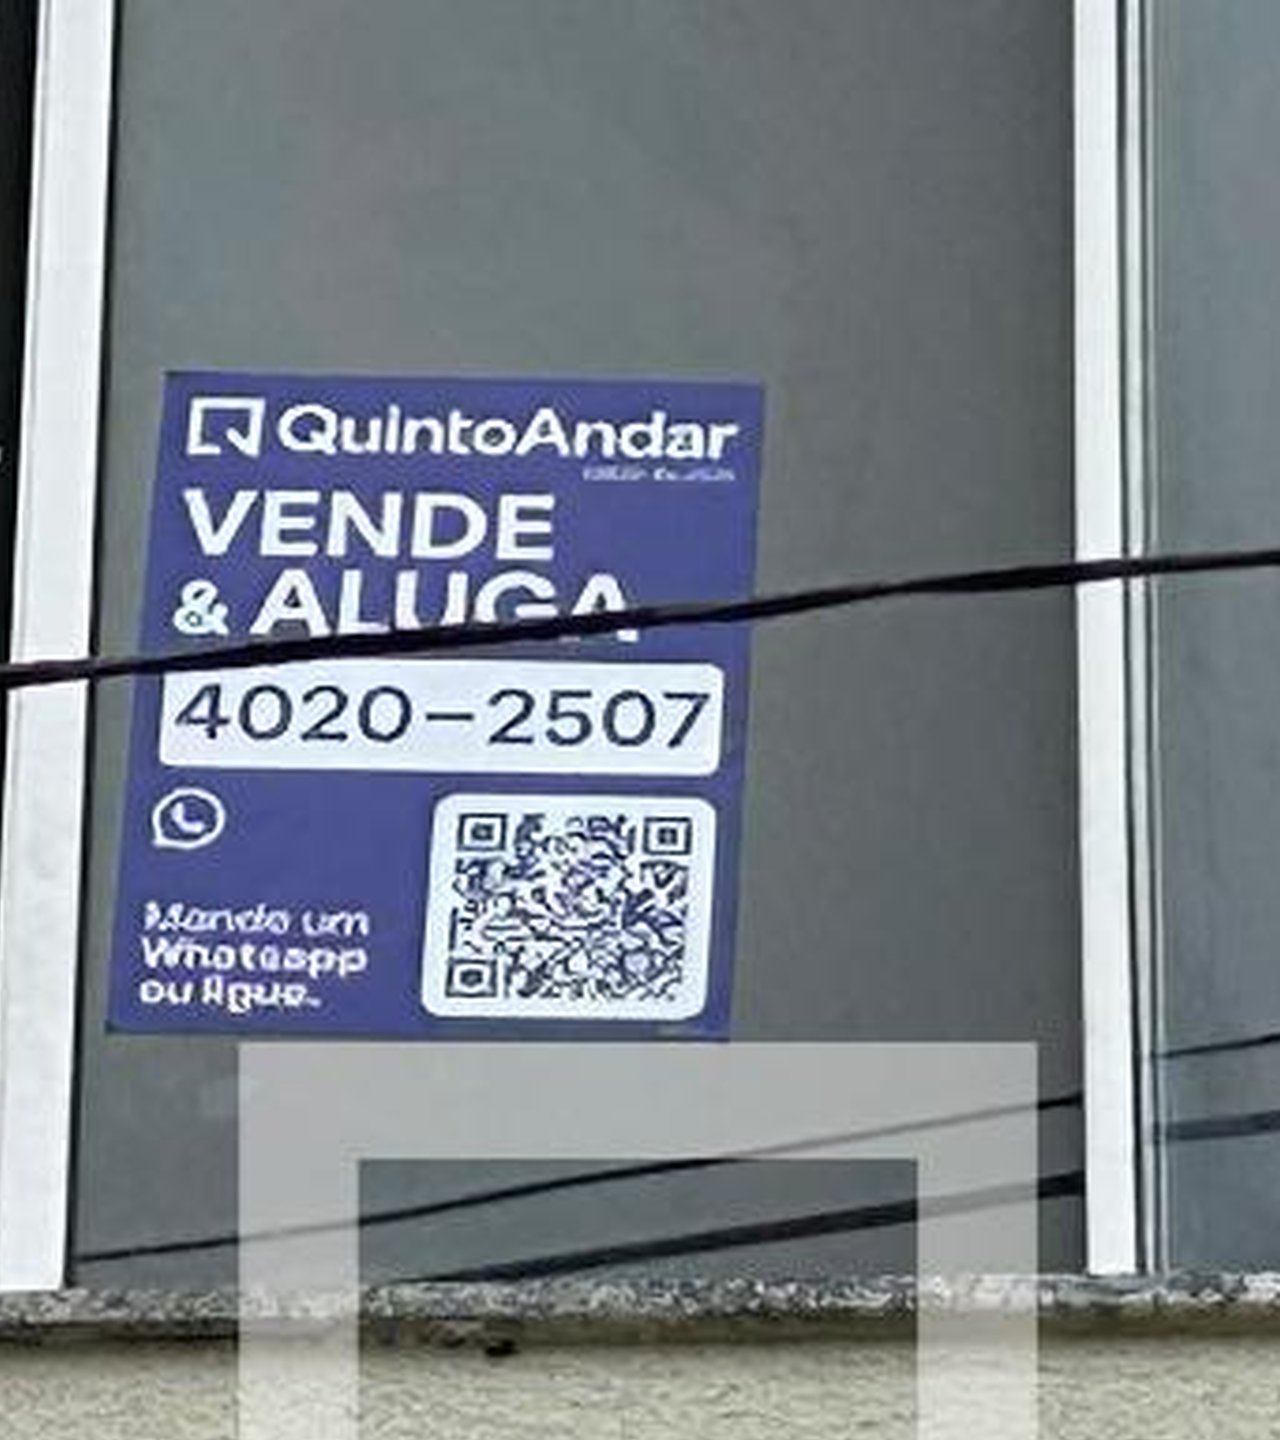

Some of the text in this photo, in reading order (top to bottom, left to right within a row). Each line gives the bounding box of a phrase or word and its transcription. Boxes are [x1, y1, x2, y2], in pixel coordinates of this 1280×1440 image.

[277, 404, 740, 460] QuintoAndar
[183, 489, 556, 560] VENDE
[172, 569, 639, 641] & ALUGA
[174, 683, 710, 750] 4020-2507
